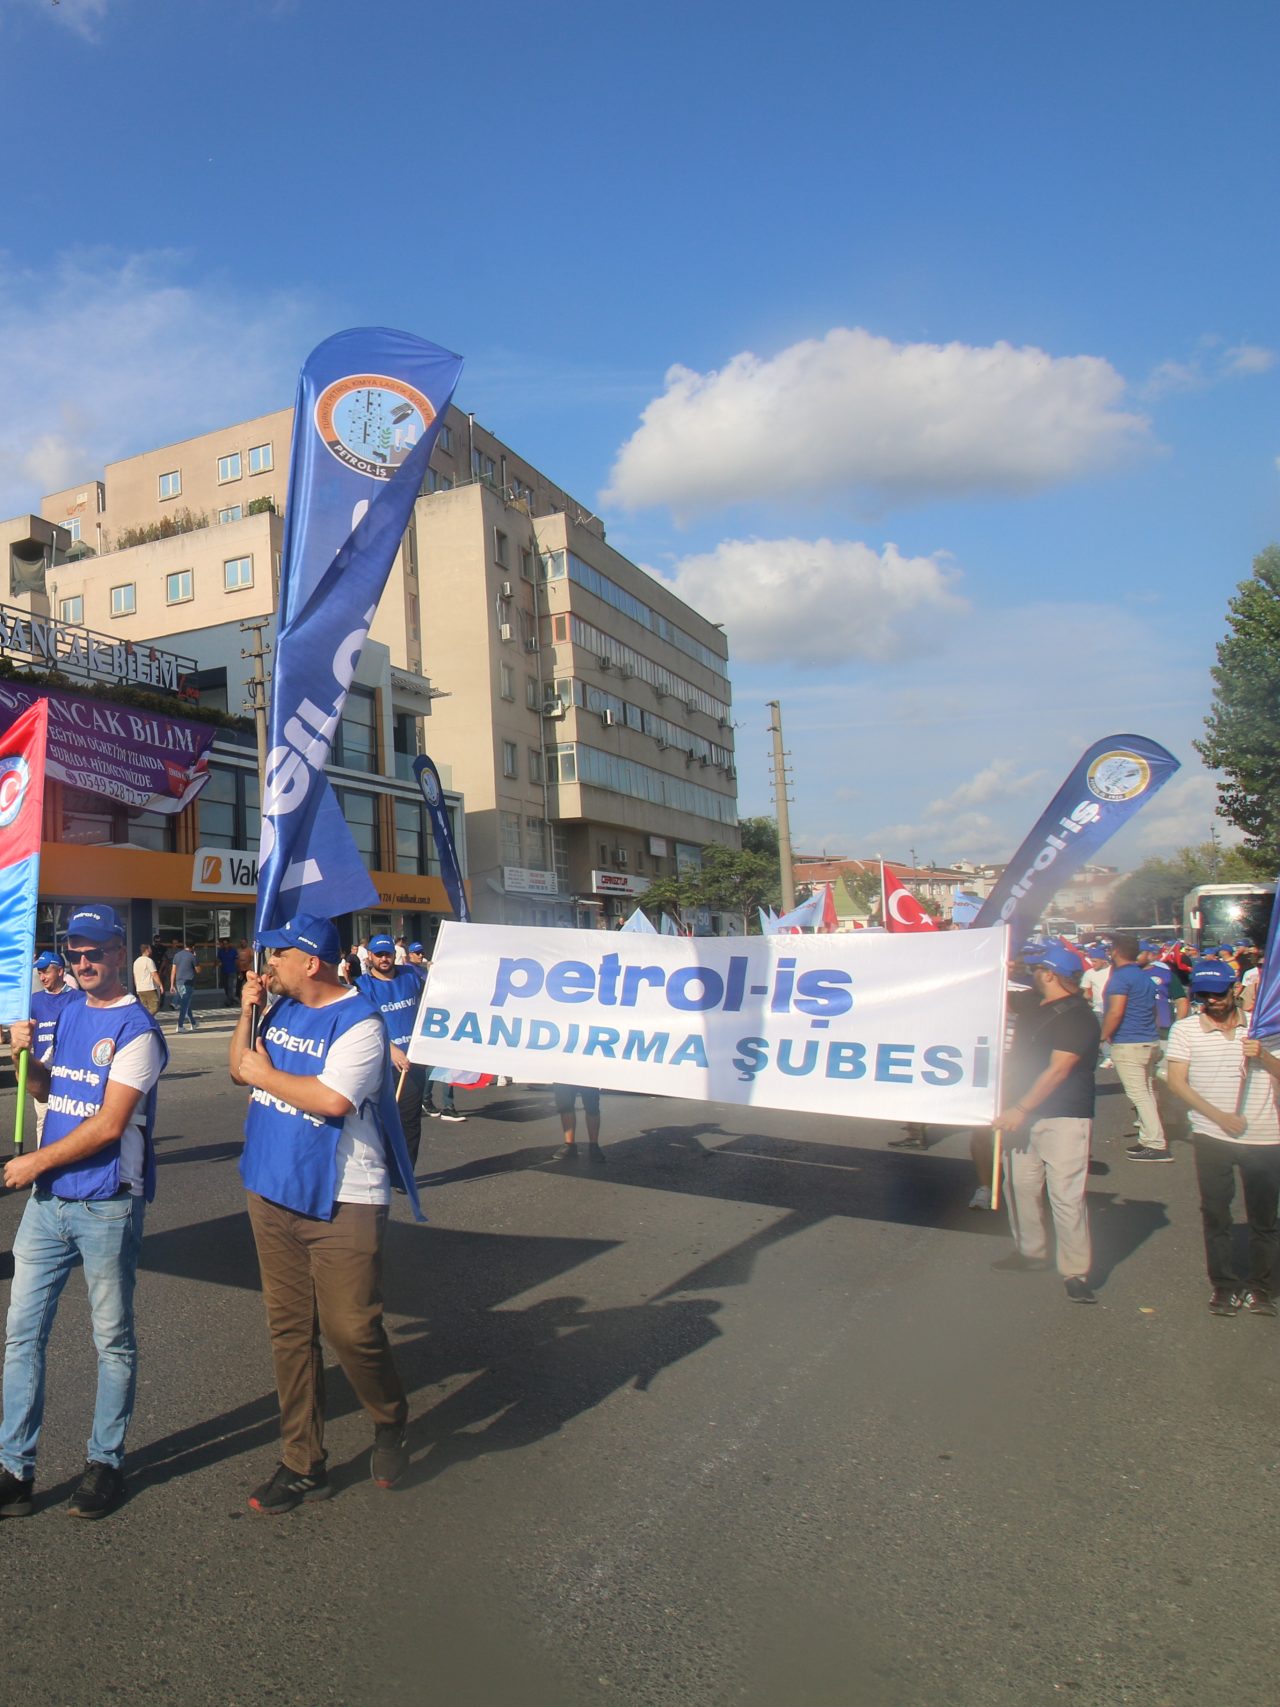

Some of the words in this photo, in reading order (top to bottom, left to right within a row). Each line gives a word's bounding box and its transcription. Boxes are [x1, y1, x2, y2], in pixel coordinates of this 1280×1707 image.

[334, 444, 387, 478] PETROL-İŞ
[128, 714, 196, 753] BİLİM
[78, 771, 106, 792] 0549
[992, 800, 1101, 928] etrol-iş
[490, 952, 854, 1029] petrol-iş
[266, 1026, 325, 1058] GÖREVLİ
[420, 1006, 710, 1069] BANDIRMA
[732, 1034, 990, 1089] ŞUBESİ
